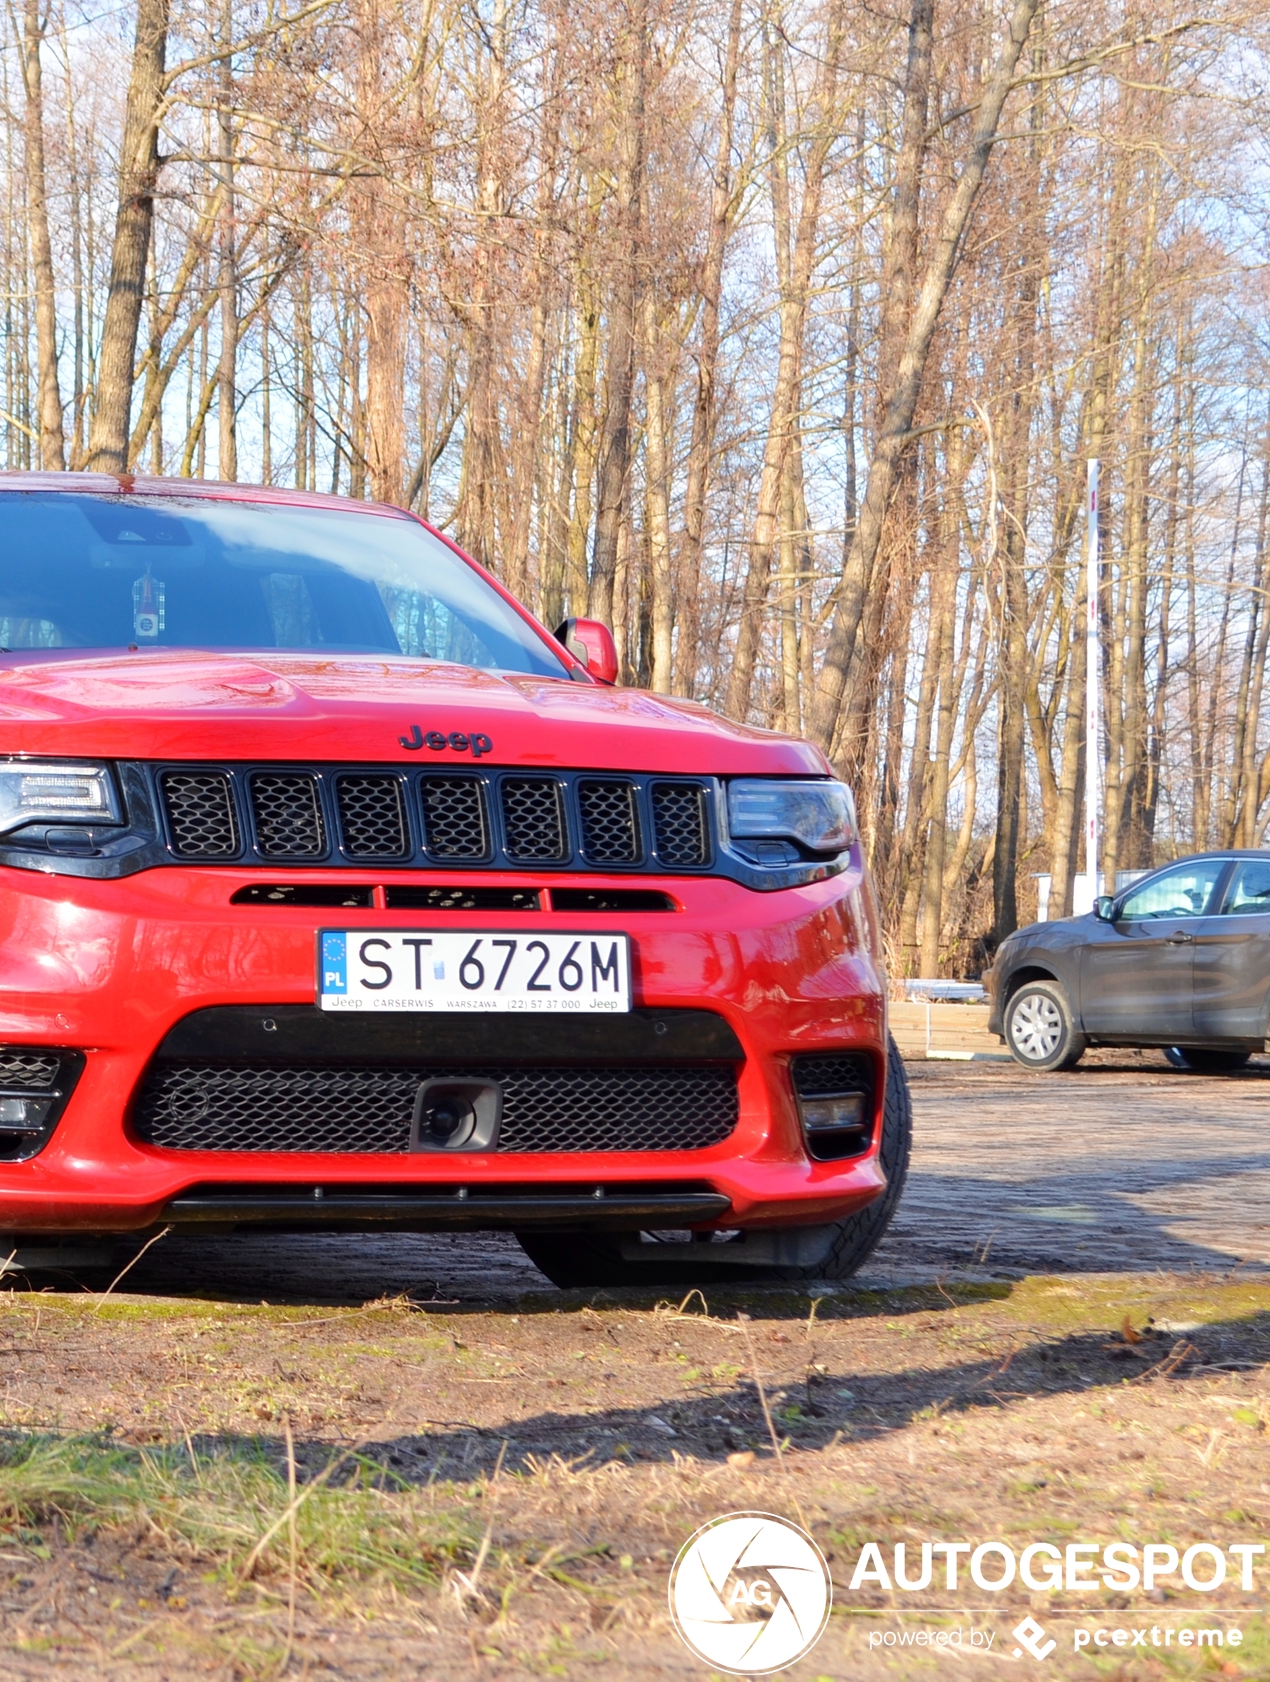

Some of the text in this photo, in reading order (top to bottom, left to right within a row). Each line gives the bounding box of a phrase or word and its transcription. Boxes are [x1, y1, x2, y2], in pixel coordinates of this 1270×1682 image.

[398, 725, 493, 757] Jeep
[359, 938, 620, 993] ST 6726M
[325, 972, 344, 986] PL
[331, 996, 618, 1010] Jeep CARSERWIS WARSZAWA (22) 57 37 000 Jeep
